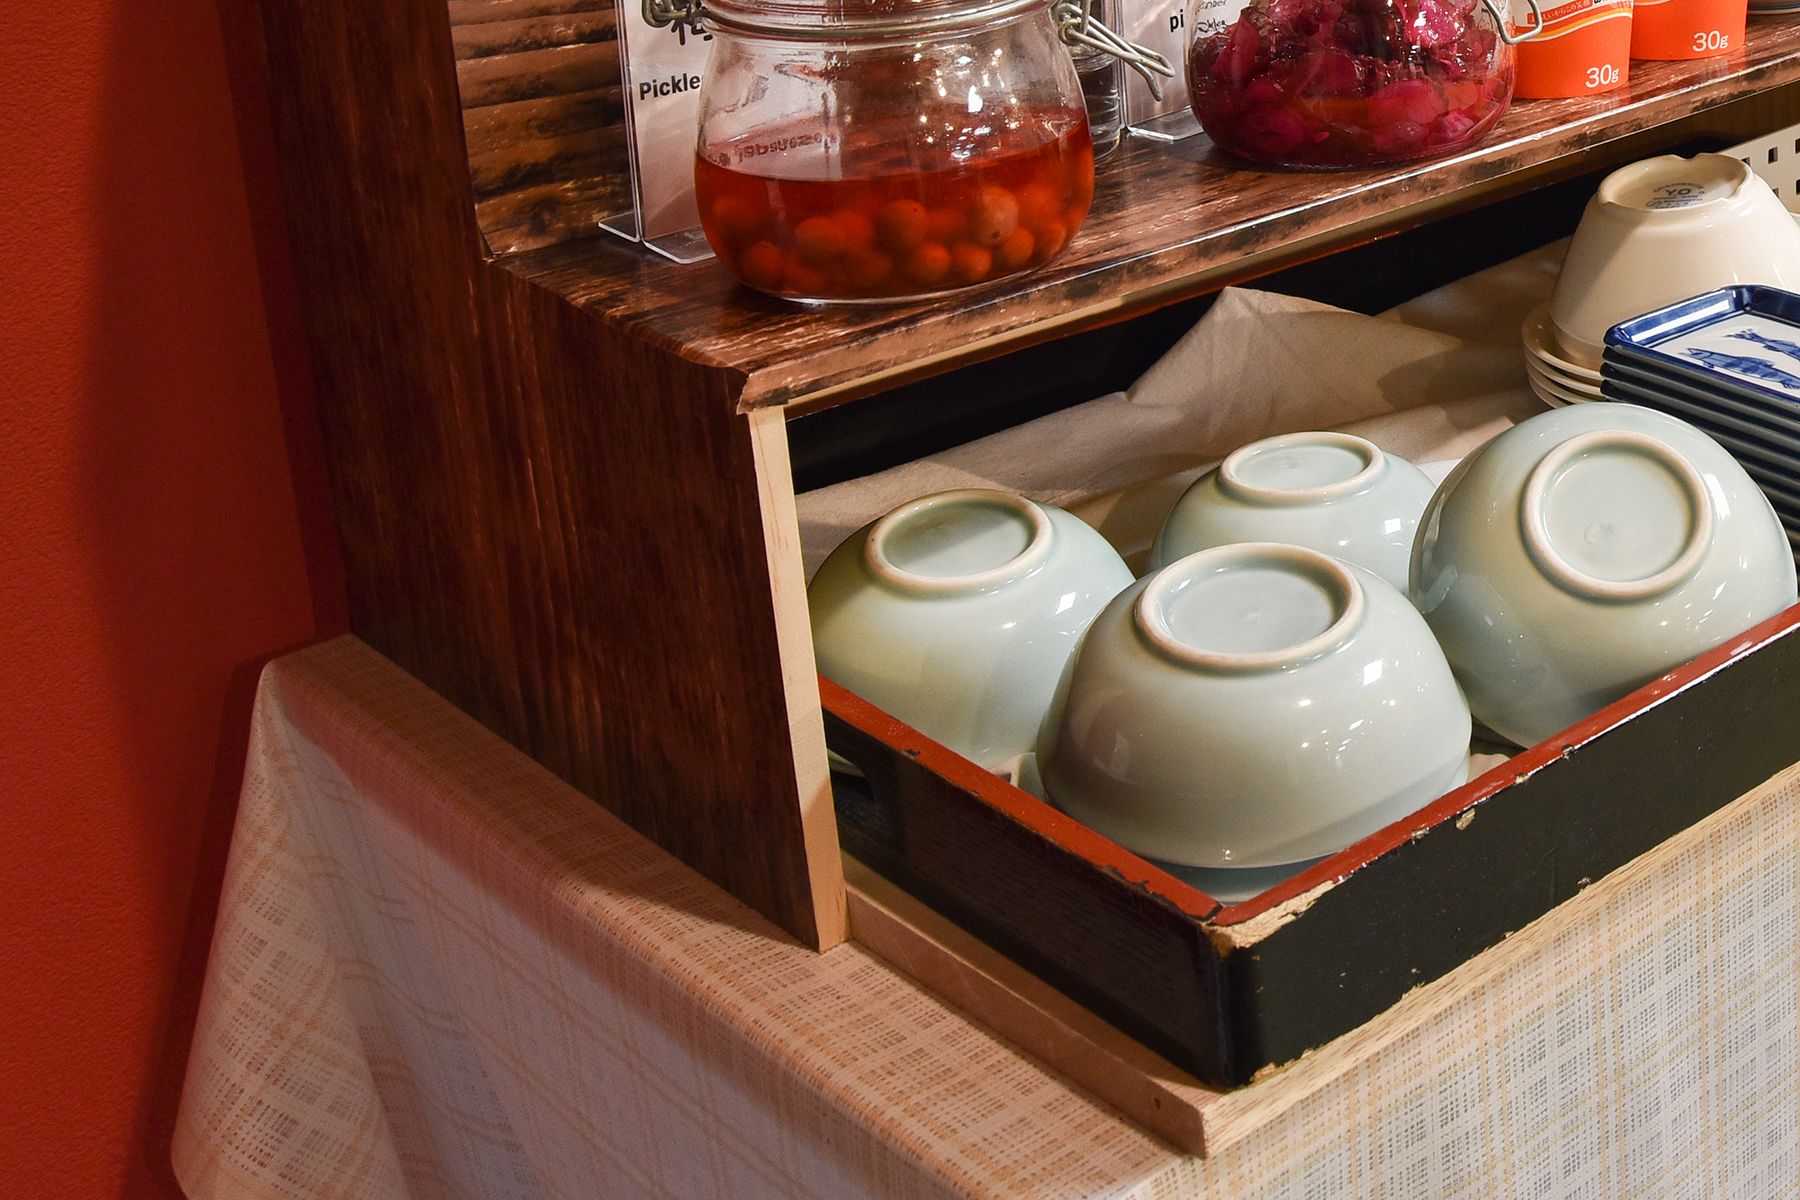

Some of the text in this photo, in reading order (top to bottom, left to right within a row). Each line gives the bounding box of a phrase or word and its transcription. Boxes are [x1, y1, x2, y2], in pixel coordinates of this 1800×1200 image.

[1691, 30, 1729, 52] 30g
[639, 72, 702, 101] Pickle
[1585, 63, 1619, 89] 30g
